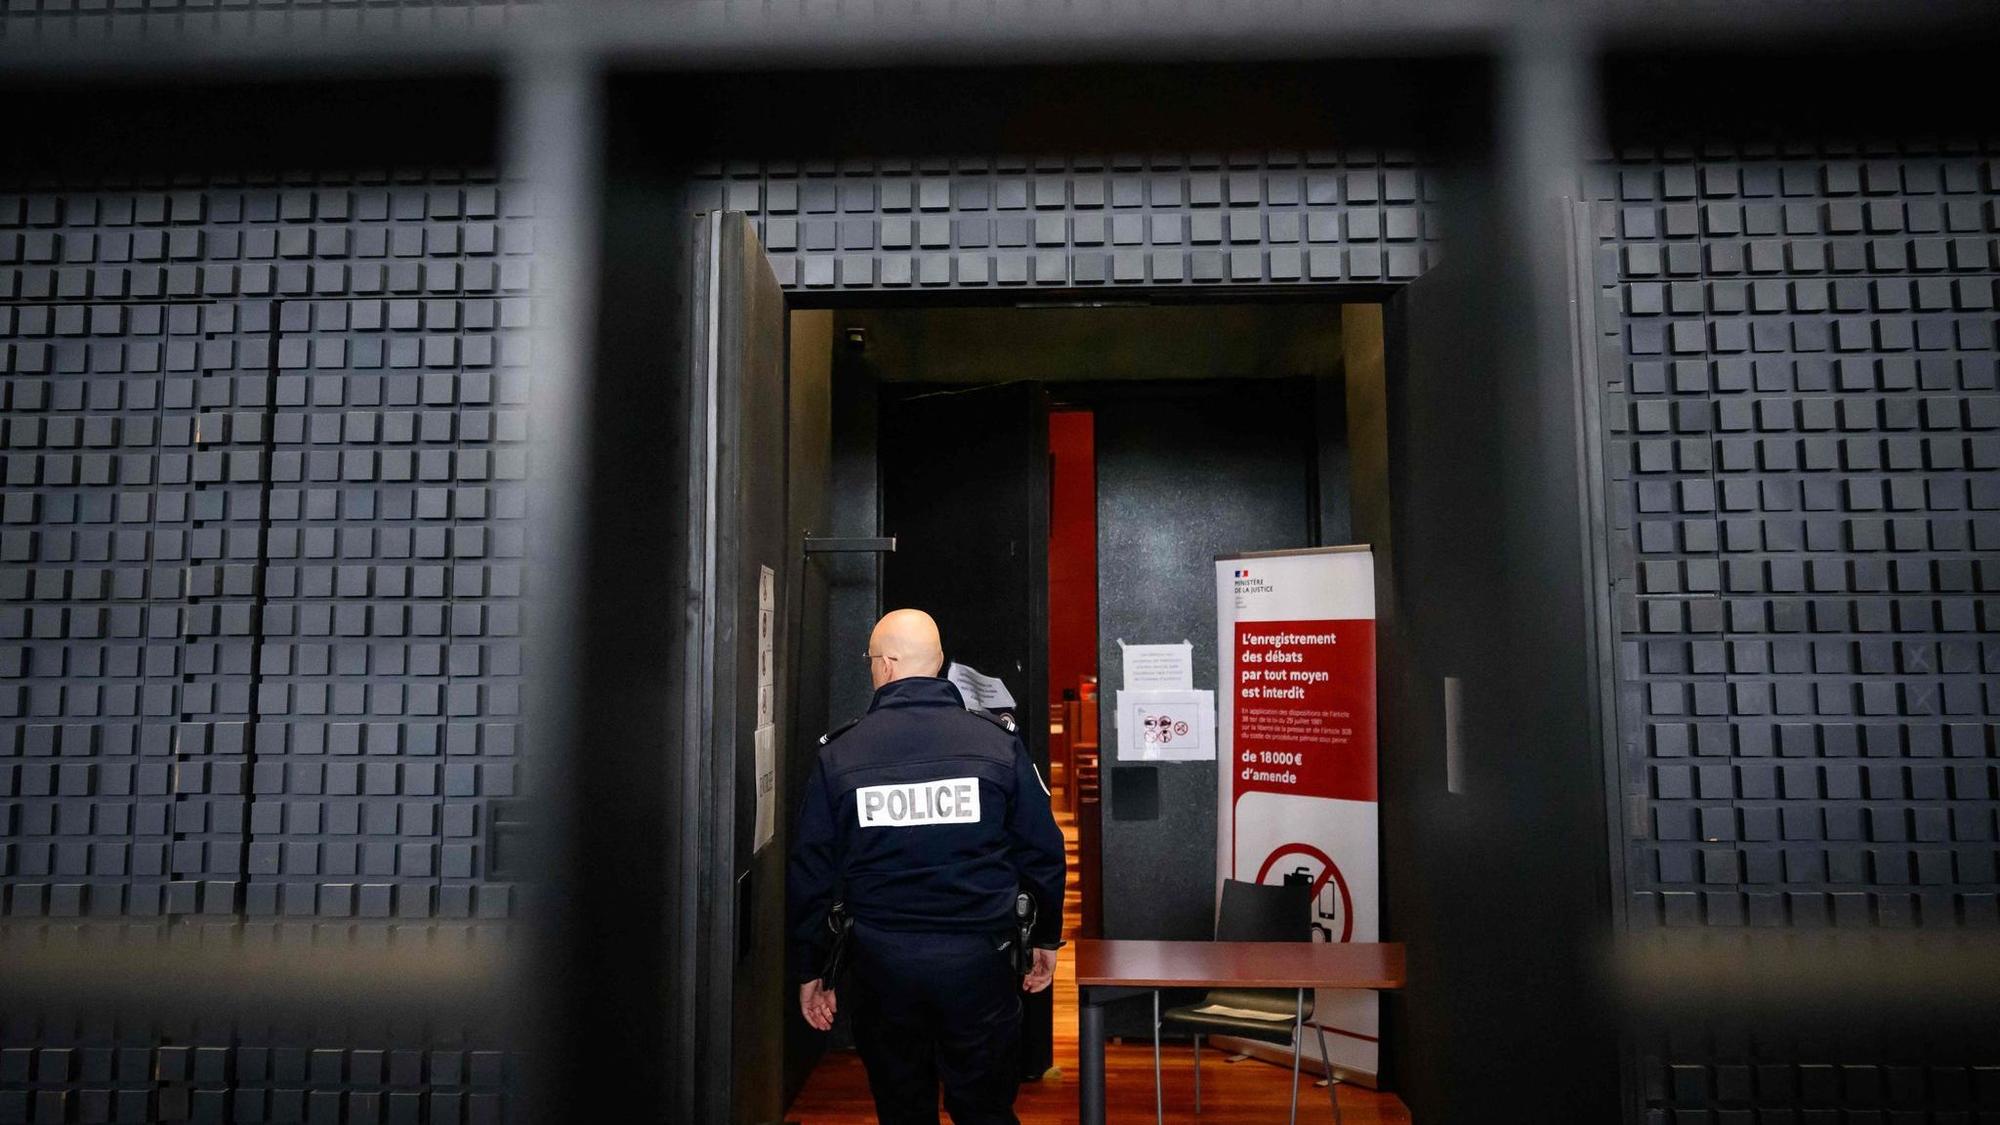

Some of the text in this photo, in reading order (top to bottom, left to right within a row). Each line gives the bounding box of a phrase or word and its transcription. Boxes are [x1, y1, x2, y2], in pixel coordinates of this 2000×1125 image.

[1242, 632, 1336, 648] L'enregistrement
[1242, 650, 1303, 662] des débats
[1242, 670, 1328, 685] par tout moyen
[1242, 686, 1305, 699] est interdit
[1242, 750, 1257, 762] de
[1242, 768, 1296, 784] d'amende
[864, 785, 972, 821] POLICE
